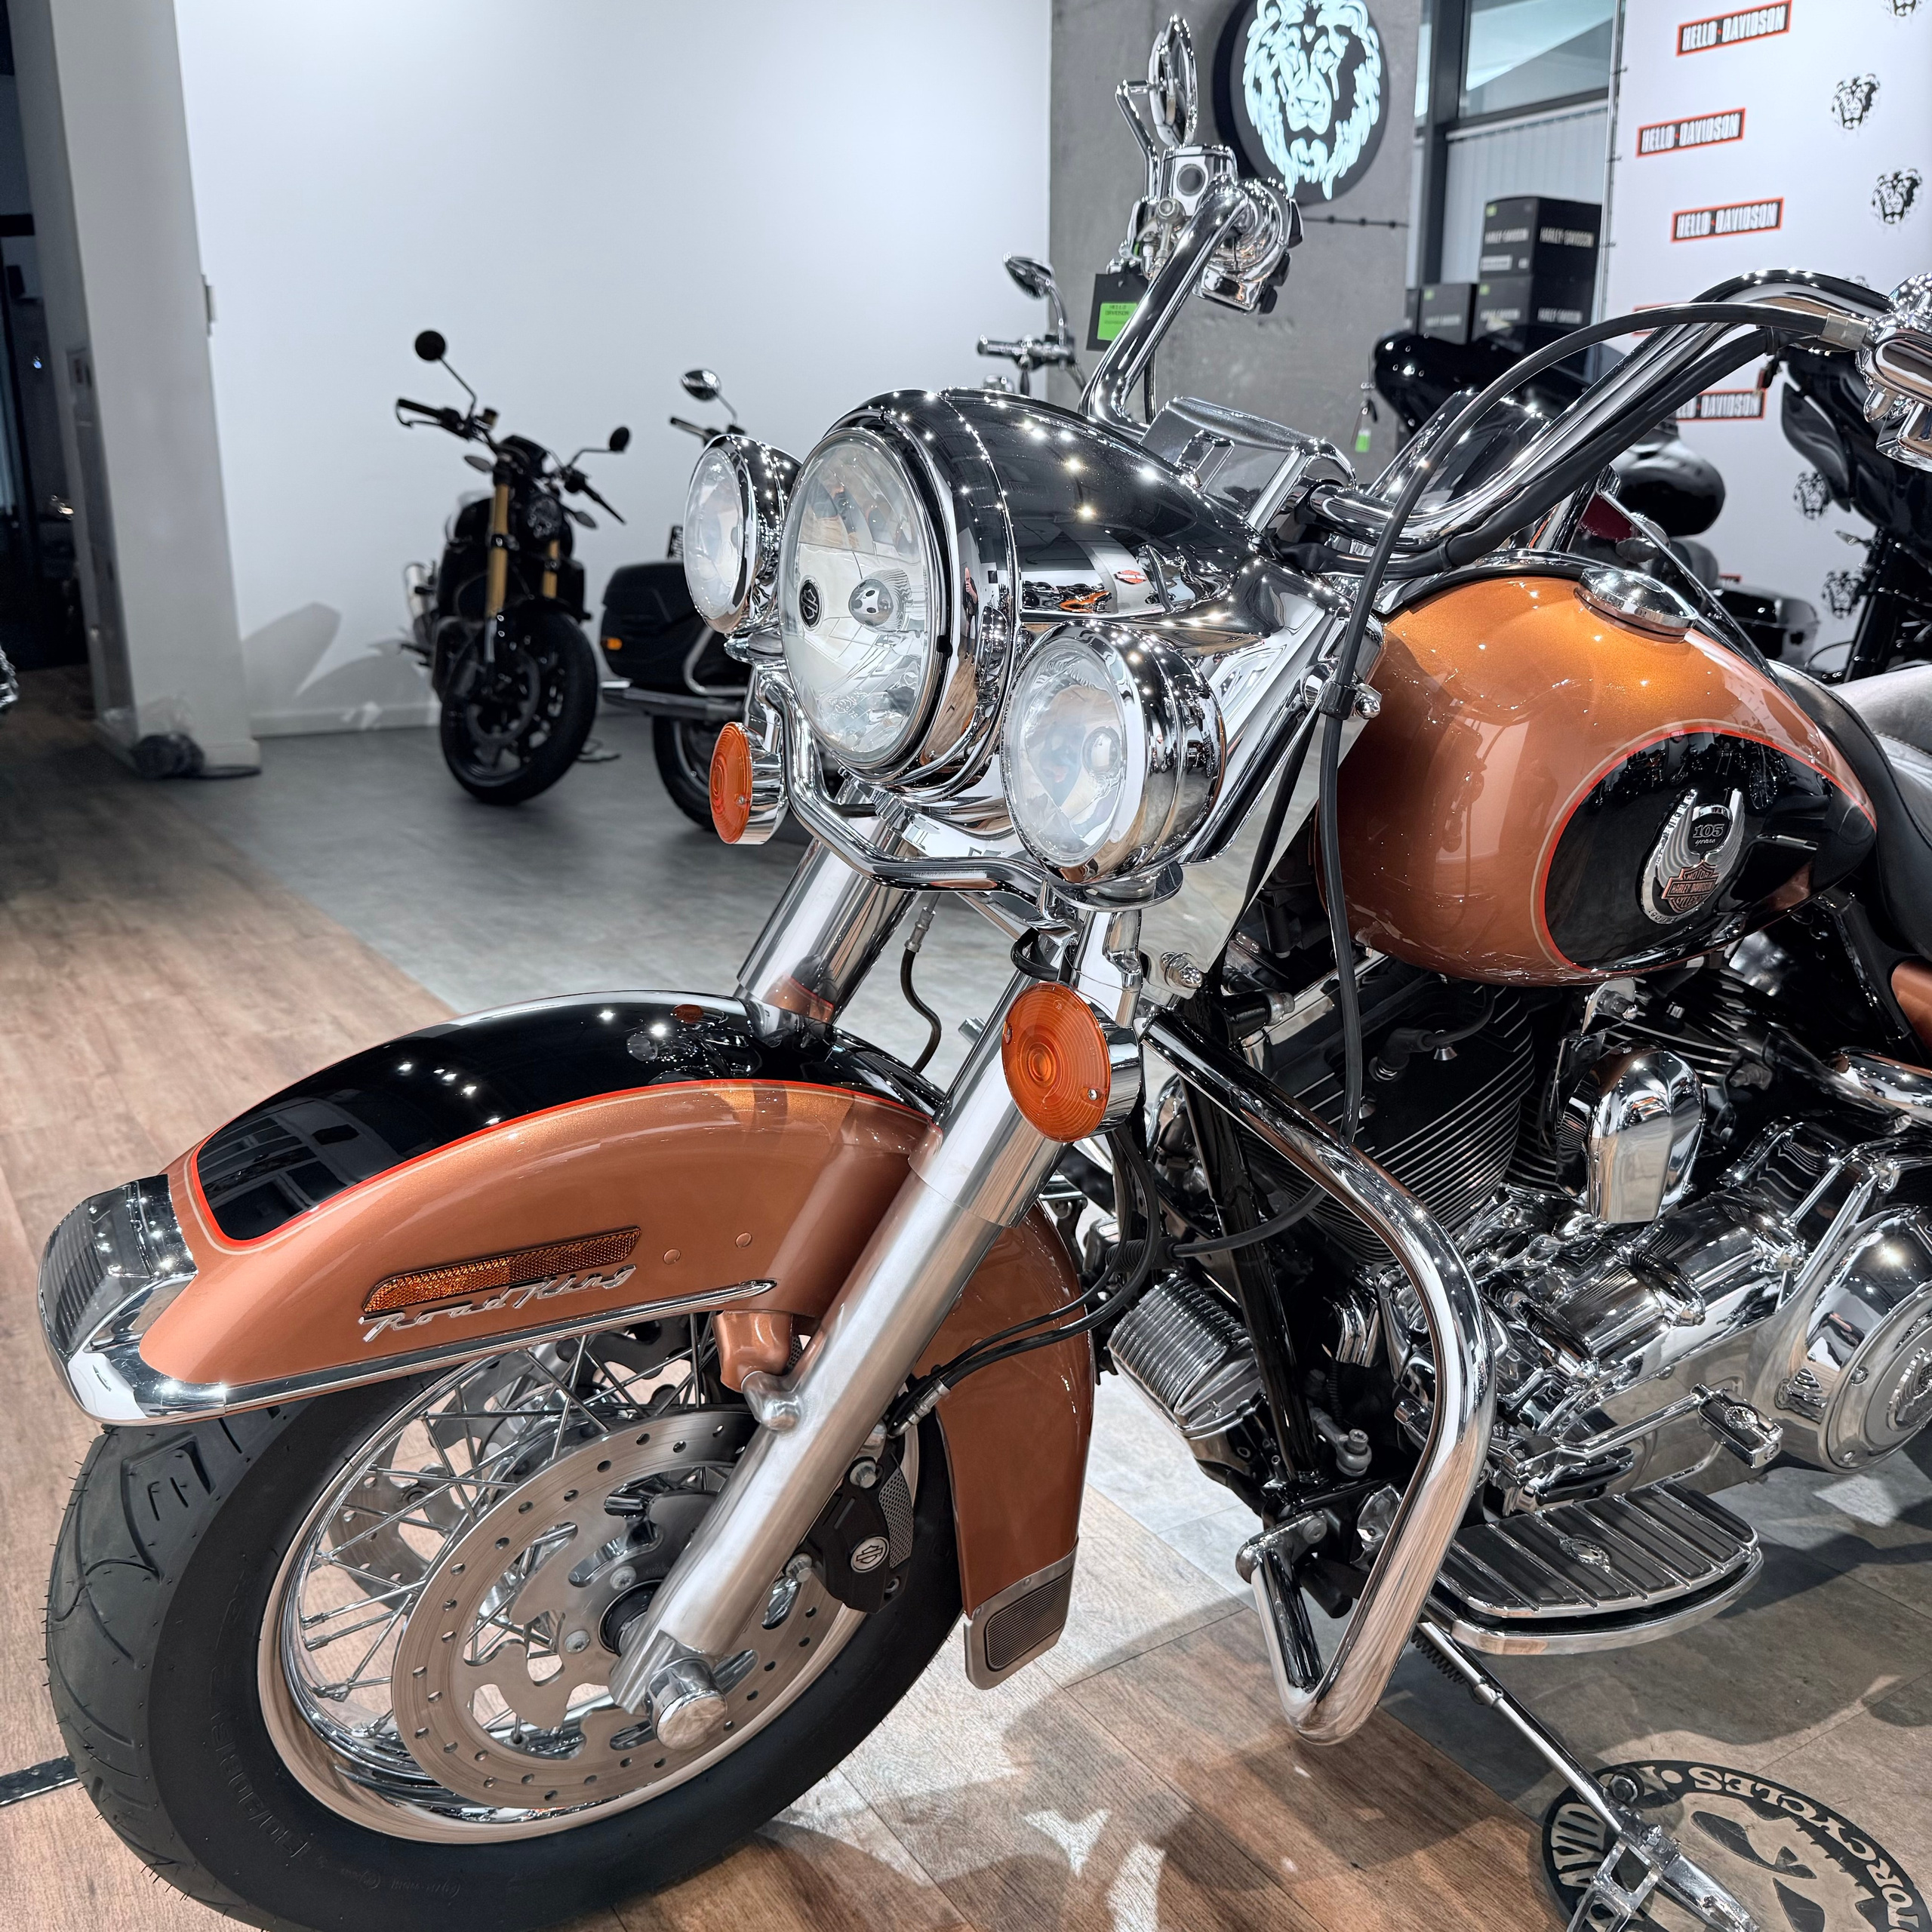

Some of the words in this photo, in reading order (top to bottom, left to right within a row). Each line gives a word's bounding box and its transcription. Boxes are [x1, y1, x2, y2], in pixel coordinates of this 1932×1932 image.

[1681, 21, 1718, 52] HELLO
[1721, 5, 1786, 43] DAVIDSON
[1641, 125, 1676, 153] HELLO
[1678, 112, 1740, 146] DAVIDSON
[1675, 211, 1712, 238] HELLO
[1715, 202, 1778, 234] DAVIDSON
[1700, 393, 1762, 418] DAVIDSON
[1692, 823, 1725, 838] 105
[1694, 838, 1716, 848] years
[1686, 869, 1710, 881] MOTOR
[359, 1282, 512, 1343] Road
